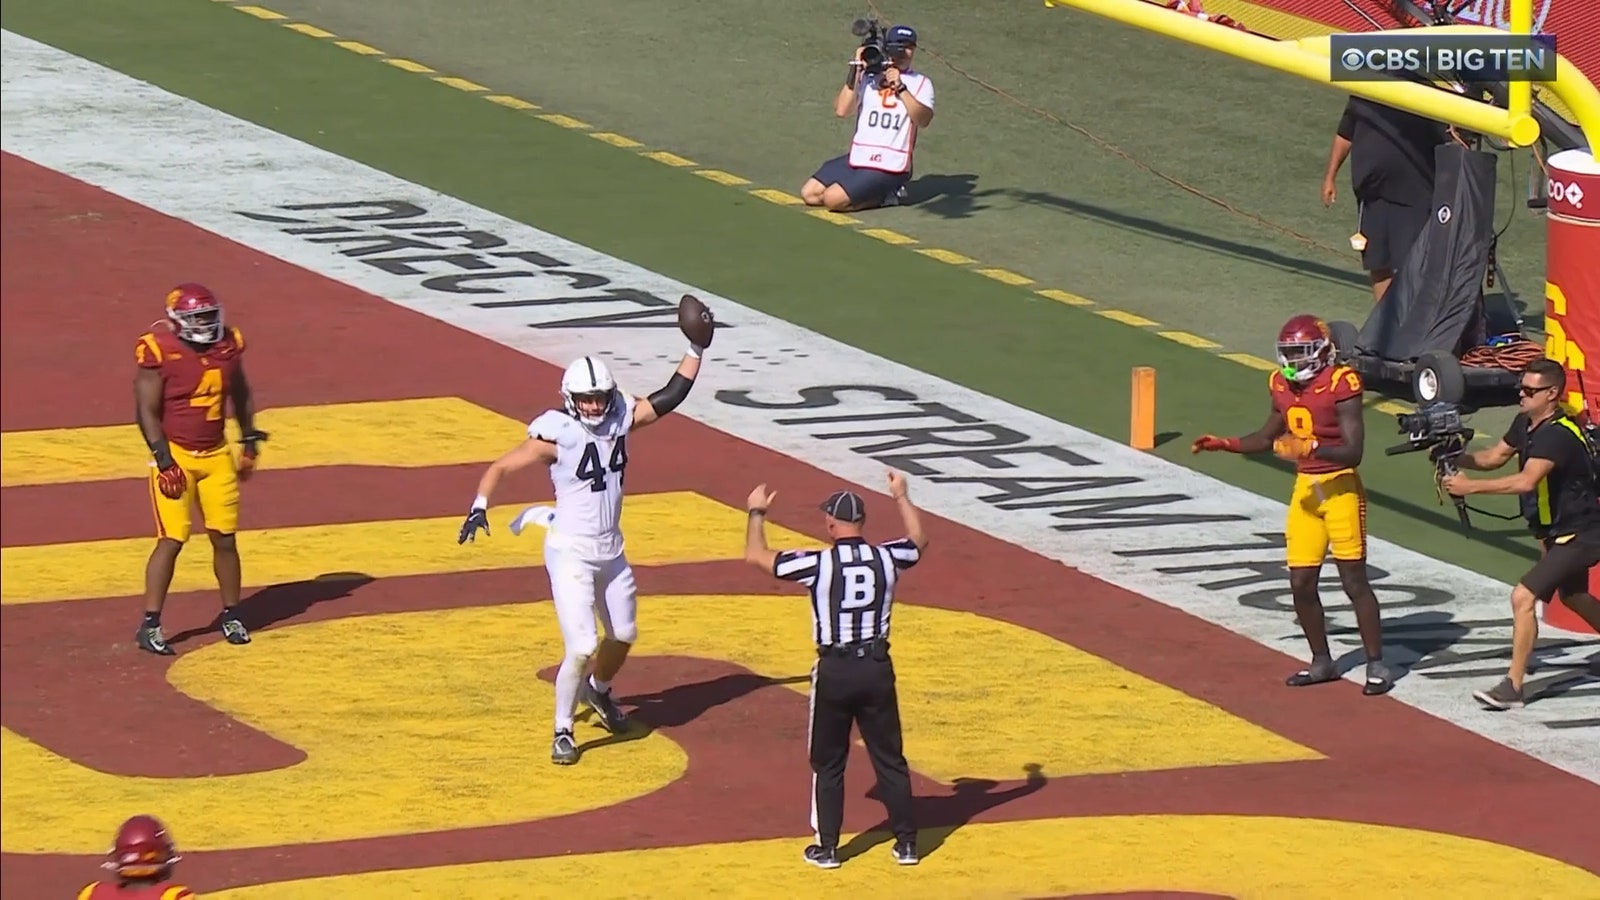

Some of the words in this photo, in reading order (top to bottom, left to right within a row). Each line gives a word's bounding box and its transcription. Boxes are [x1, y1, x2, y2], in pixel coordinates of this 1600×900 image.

[868, 110, 901, 130] 001
[233, 199, 735, 330] DIRECTV
[715, 384, 1250, 532] STREAM
[189, 368, 223, 421] 4
[576, 434, 629, 493] 44
[840, 566, 876, 609] B
